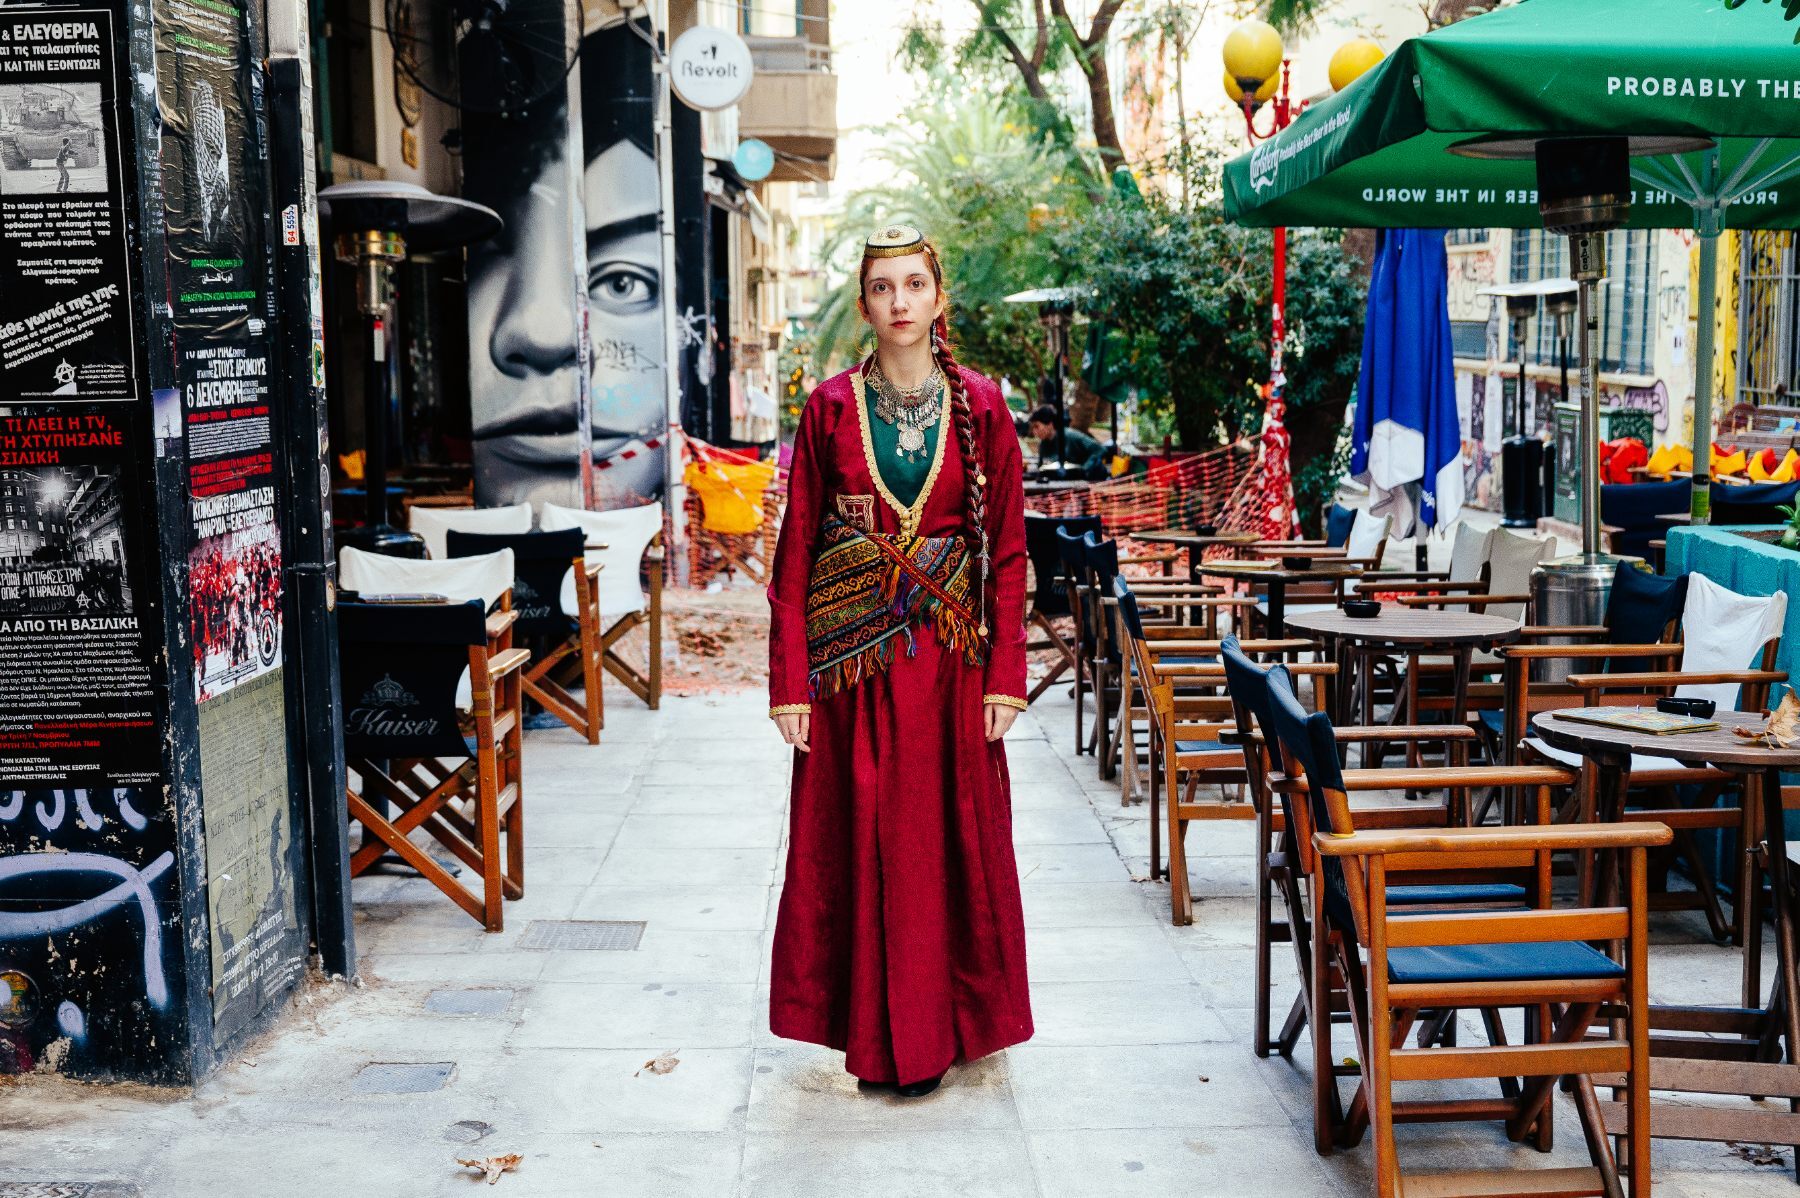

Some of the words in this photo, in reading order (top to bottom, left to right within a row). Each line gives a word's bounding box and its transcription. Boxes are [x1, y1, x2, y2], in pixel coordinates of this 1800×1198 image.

[2, 30, 10, 40] &
[13, 23, 99, 40] ΕΛΕΥΘΕΡΙΑ
[13, 45, 29, 57] τις
[32, 42, 100, 55] παλαιστίνιες
[5, 61, 22, 71] ΚΑΙ
[24, 60, 44, 71] ΤΗΝ
[47, 59, 100, 71] ΕΞΟΝΤΩΣΗ
[682, 60, 737, 77] Revolt
[1607, 76, 1747, 98] PROBABLY
[1757, 79, 1800, 99] THE
[287, 231, 296, 242] 64
[24, 301, 67, 331] γωνιά
[66, 294, 93, 311] της
[91, 284, 119, 303] γης
[2, 335, 29, 349] ενάντια
[39, 322, 63, 335] κράτη,
[213, 359, 234, 378] ΣΤΟΥΣ
[235, 357, 267, 376] ΔΡΟΜΟΥΣ
[186, 383, 194, 408] 6
[196, 380, 243, 408] ΔΕΚΕΜΒΡΗ
[5, 419, 22, 432] ΤΙ
[27, 417, 63, 431] ΛΕΕΙ
[68, 417, 80, 430] Η
[85, 415, 111, 431] TV,
[21, 431, 122, 449] ΧΤΥΠΗΣΑΝΕ
[0, 450, 59, 465] ΣΙΛΙΚΗ
[198, 517, 226, 540] ΑΝΑΡΧΙΑ
[23, 567, 84, 586] ΑΝΤΙΦΑΣΙΣΤΡΙΑ
[1, 586, 20, 600] ΟΠΚΕ
[14, 620, 45, 632] ΑΠΟ
[48, 619, 67, 631] ΤΗ
[71, 617, 139, 631] ΒΑΣΙΛΙΚΗ
[344, 708, 440, 736] Kaiser
